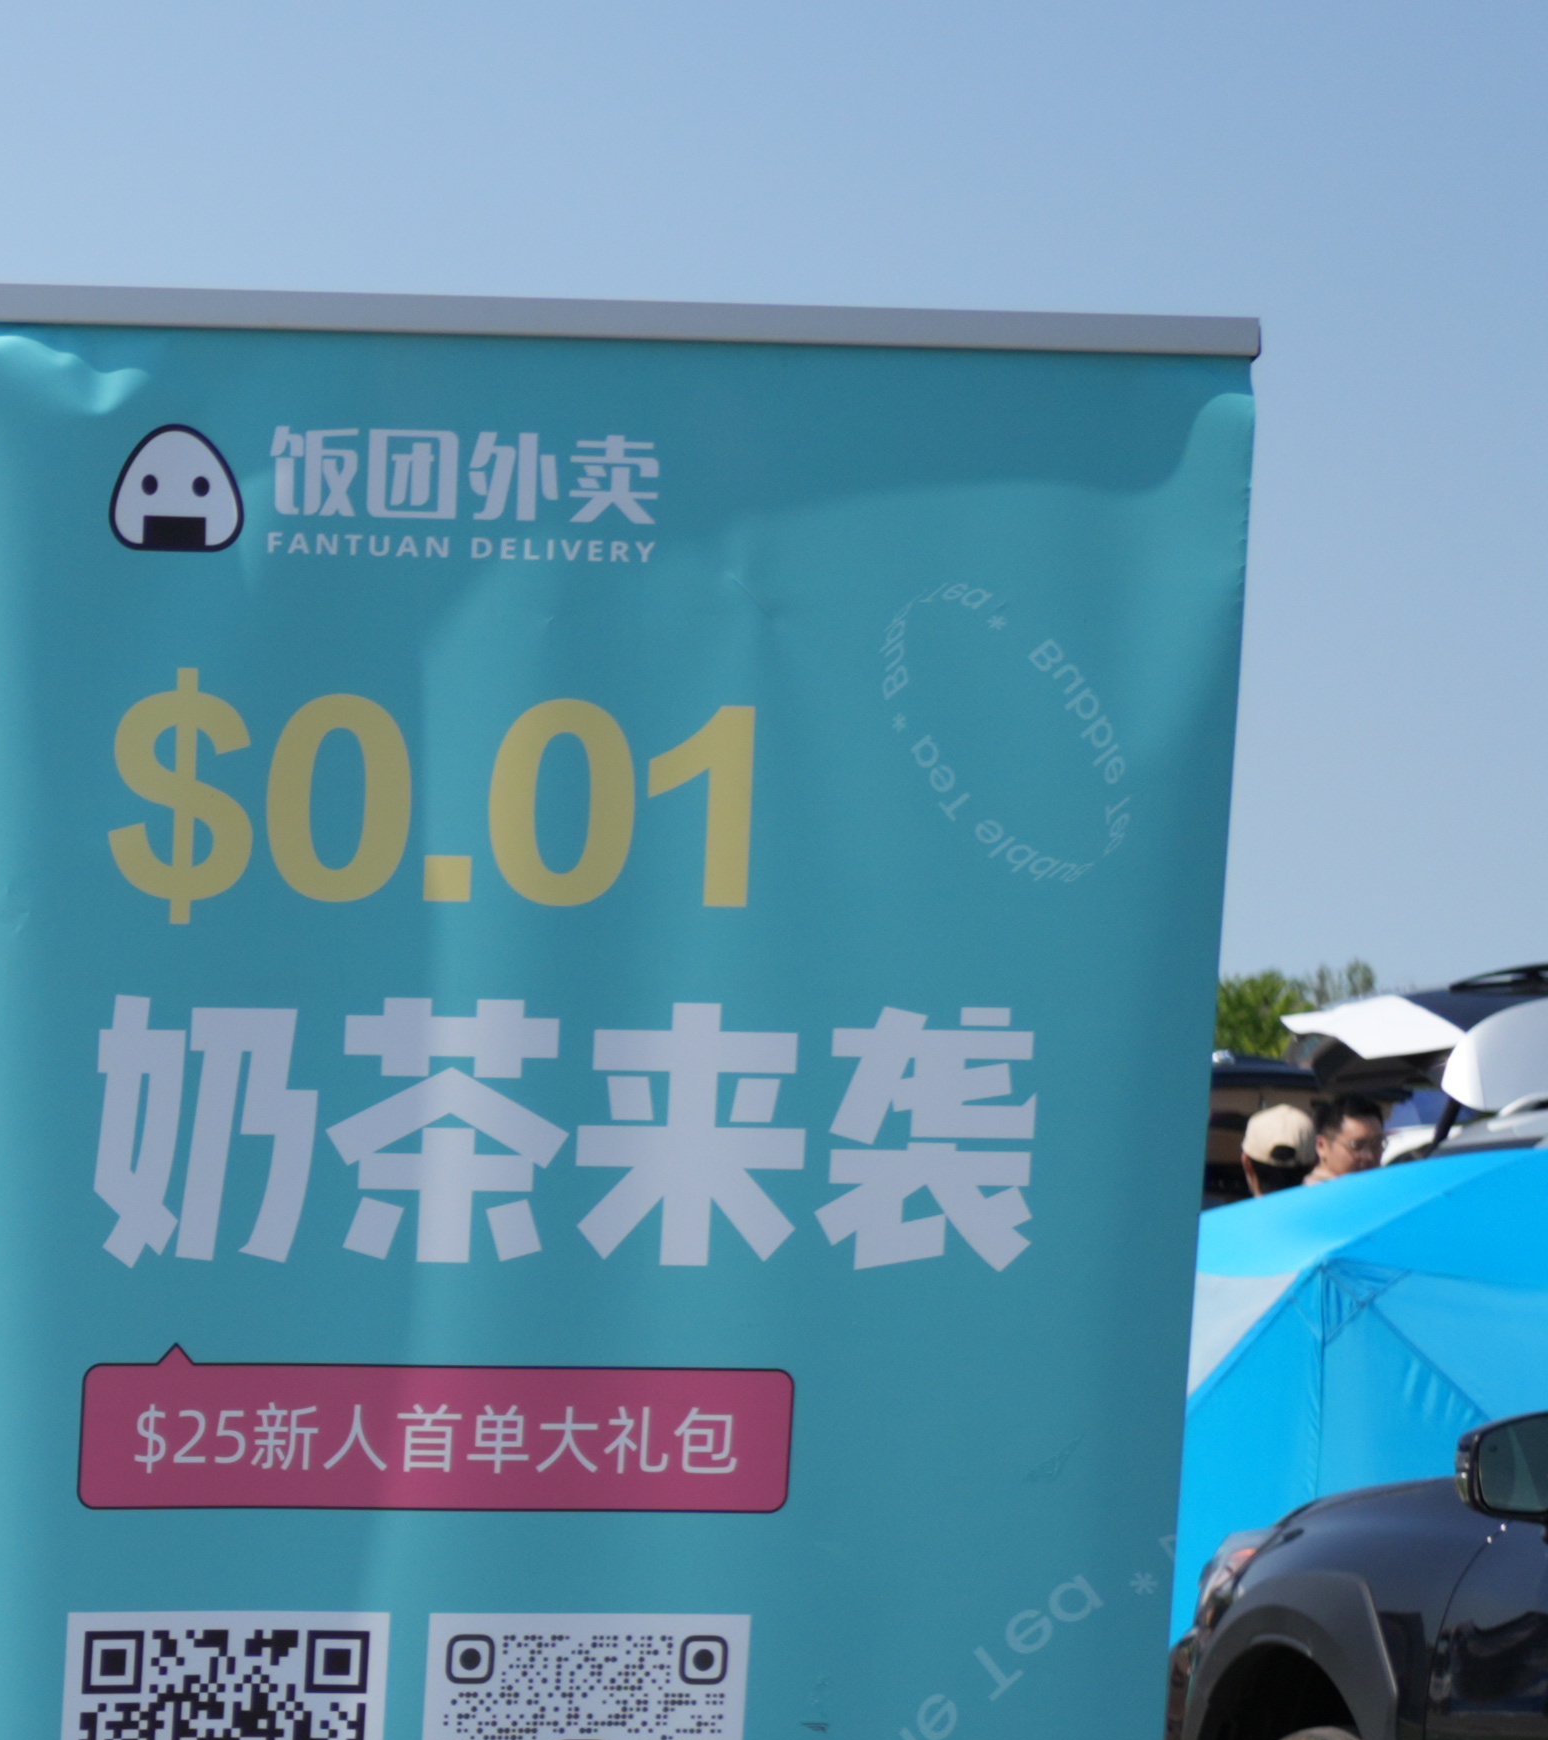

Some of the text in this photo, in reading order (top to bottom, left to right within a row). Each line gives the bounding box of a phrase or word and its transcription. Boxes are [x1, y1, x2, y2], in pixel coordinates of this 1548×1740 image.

[268, 423, 662, 527] 饭团外卖
[266, 530, 658, 565] FANTUAN DELIVERY
[106, 666, 757, 925] $0.01
[92, 993, 1038, 1274] 奶茶来袭
[131, 1400, 740, 1478] $25新人首单大礼包
